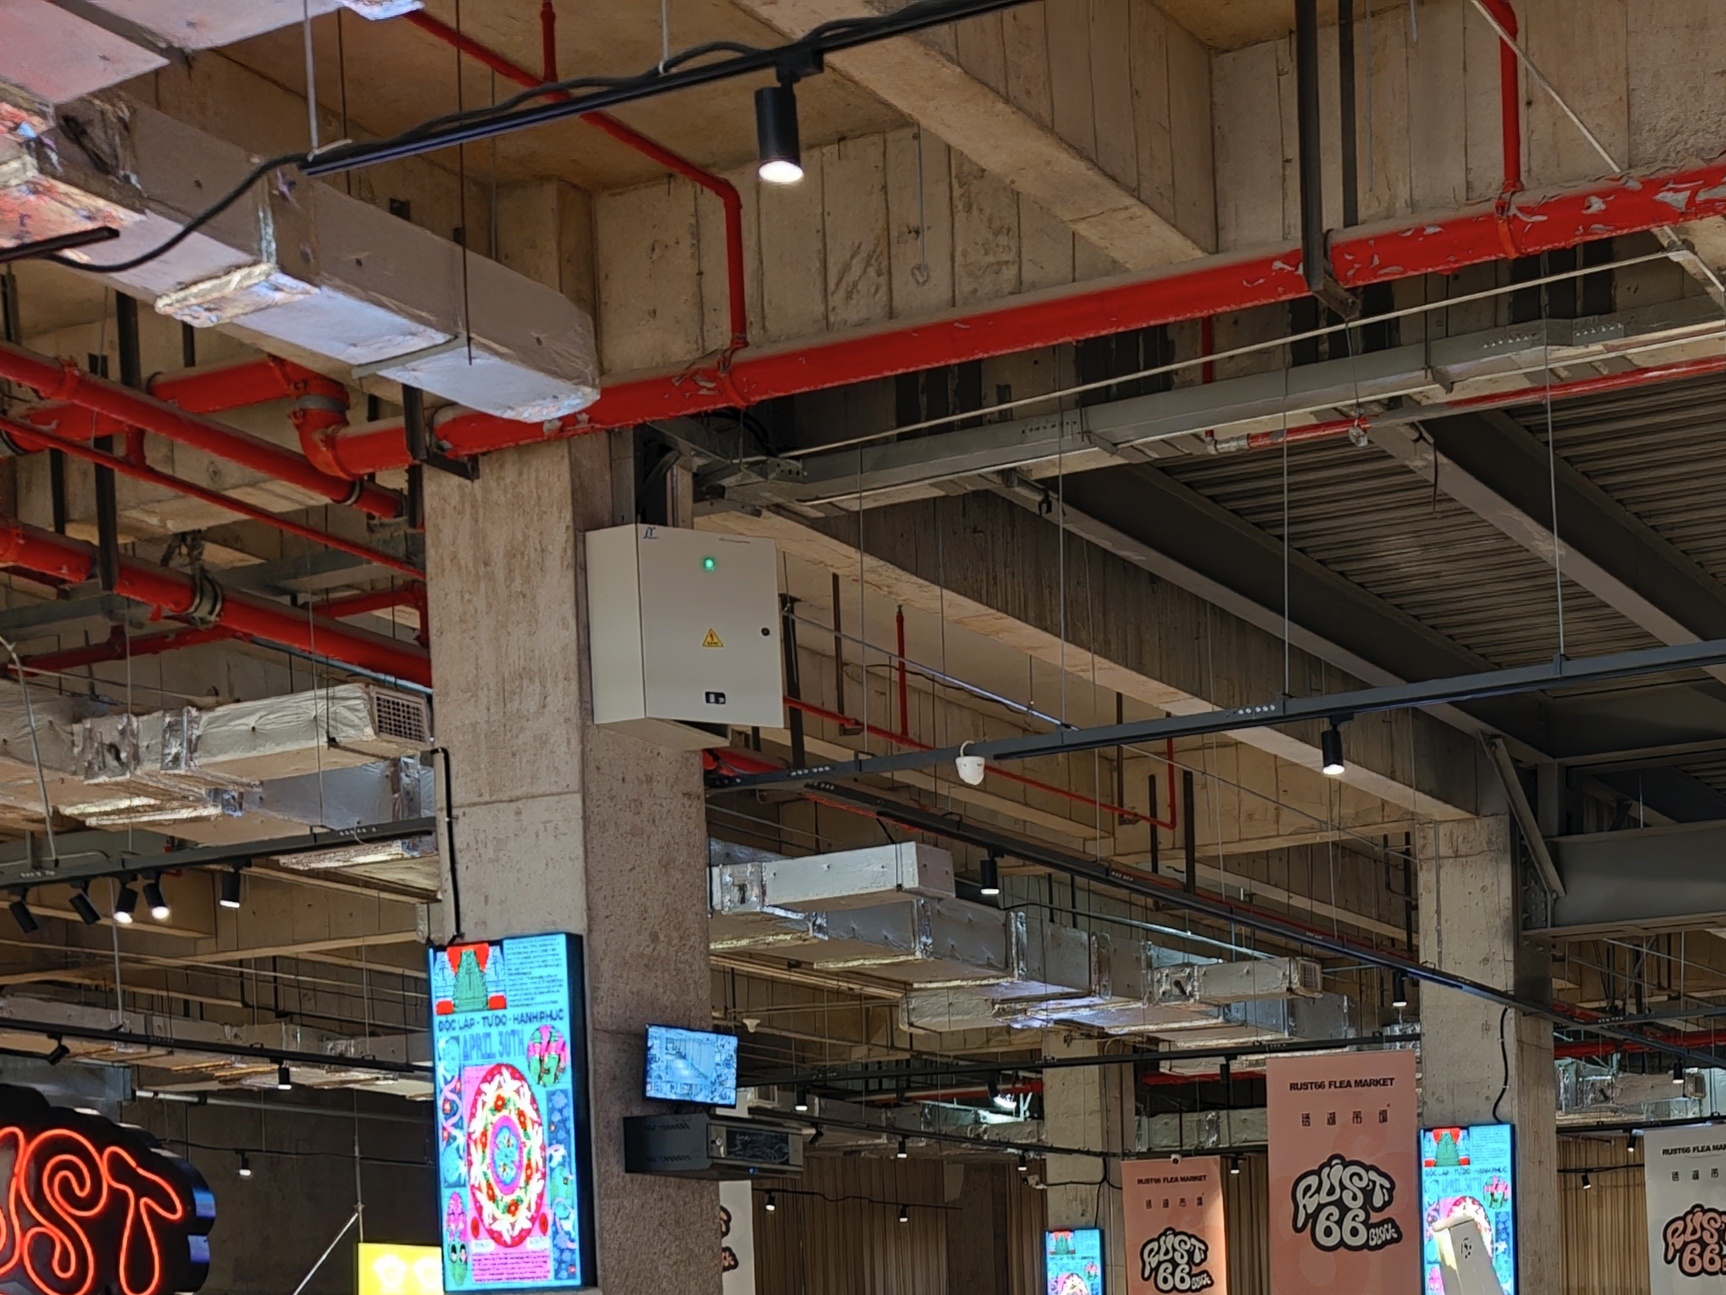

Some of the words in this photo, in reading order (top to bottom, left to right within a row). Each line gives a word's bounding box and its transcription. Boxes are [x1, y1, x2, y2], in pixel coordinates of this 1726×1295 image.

[1290, 1081, 1325, 1091] RUST66
[1328, 1079, 1352, 1089] FLEA
[1354, 1077, 1395, 1088] MARKET
[1692, 1145, 1711, 1154] FLEA
[1315, 1205, 1367, 1247] 66
[1682, 1243, 1722, 1274] 66
[1157, 1263, 1191, 1291] 66
